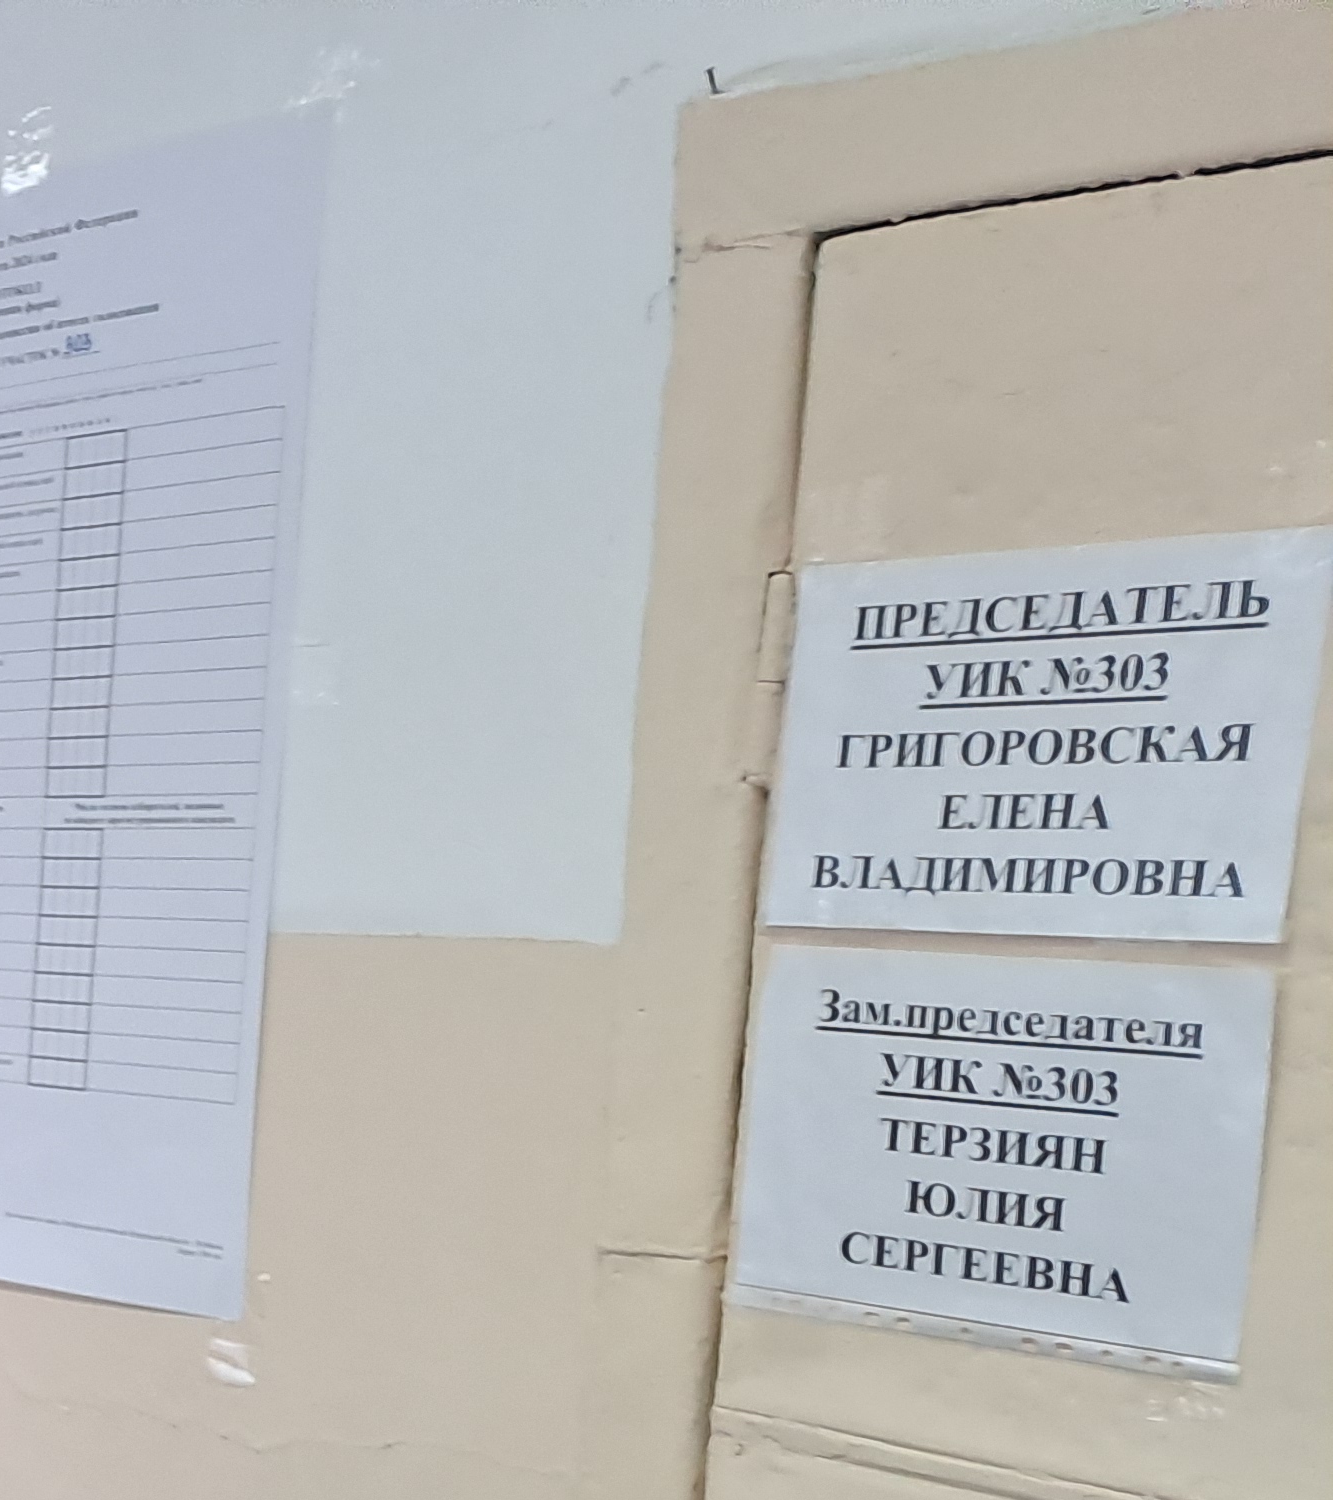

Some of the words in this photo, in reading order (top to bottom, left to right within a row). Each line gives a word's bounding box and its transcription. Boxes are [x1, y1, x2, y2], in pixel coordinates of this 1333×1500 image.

[854, 579, 1271, 641] ПРЕДСЕДАТЕЛЬ
[926, 658, 1032, 700] УИК
[1040, 651, 1170, 695] №303
[836, 723, 1256, 768] ГРИГОРОВСКАЯ
[937, 794, 1110, 830] ЕЛЕНА
[811, 854, 1245, 899] ВЛАДИМИРОВНА
[819, 988, 1204, 1050] Зам.председателя
[879, 1053, 983, 1096] УИК
[992, 1063, 1120, 1106] №303
[880, 1117, 1107, 1175] ТЕРЗИЯН
[904, 1180, 1066, 1232] ЮЛИЯ
[840, 1231, 1130, 1304] СЕРГЕЕВНА
